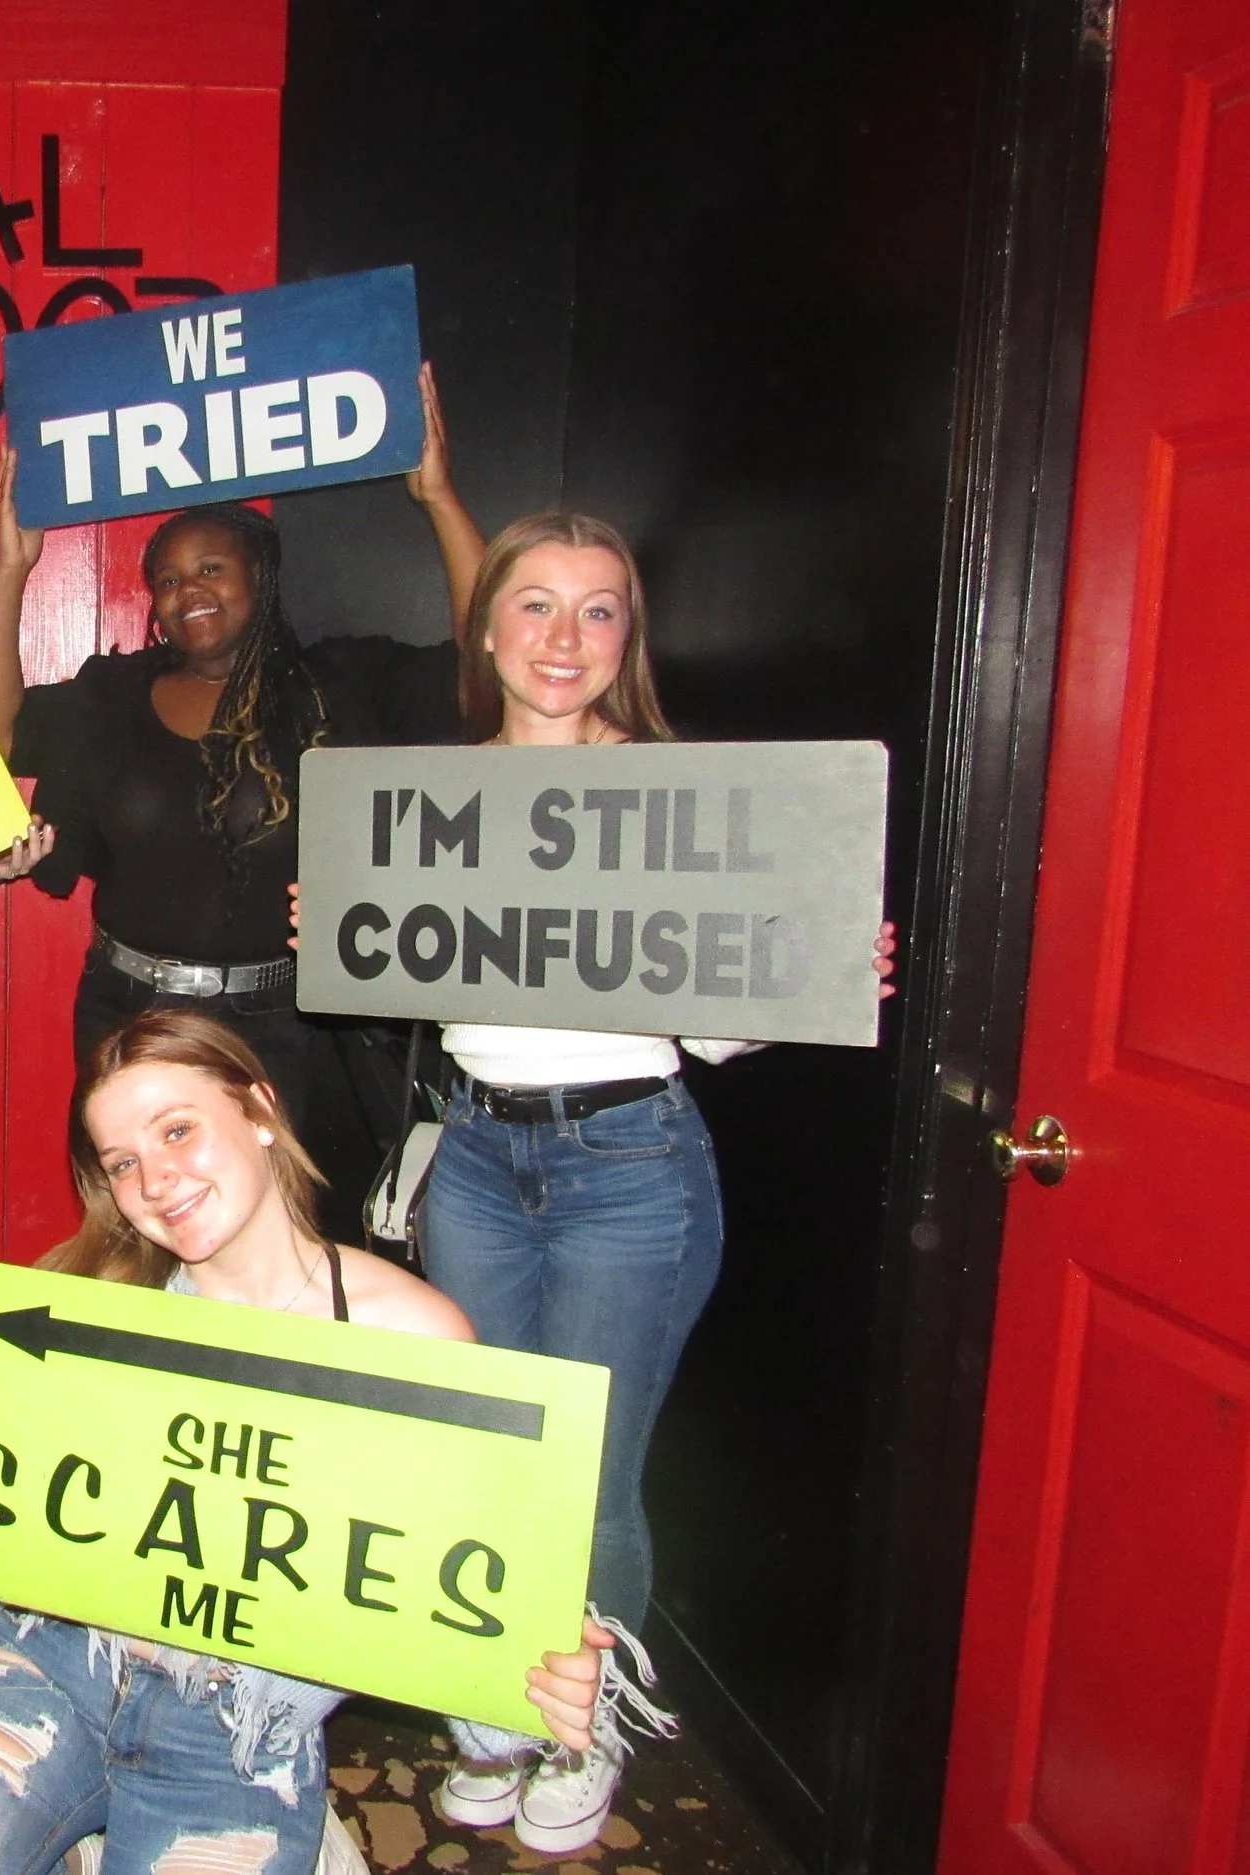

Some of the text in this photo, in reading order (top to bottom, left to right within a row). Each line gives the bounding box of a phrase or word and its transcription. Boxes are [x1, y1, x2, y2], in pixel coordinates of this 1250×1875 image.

[162, 308, 246, 385] WE
[40, 368, 388, 506] TRIED
[371, 787, 775, 874] I'M STILL
[336, 901, 816, 1000] CONFUSED
[162, 1412, 294, 1487] SHE
[160, 1576, 259, 1648] ME
